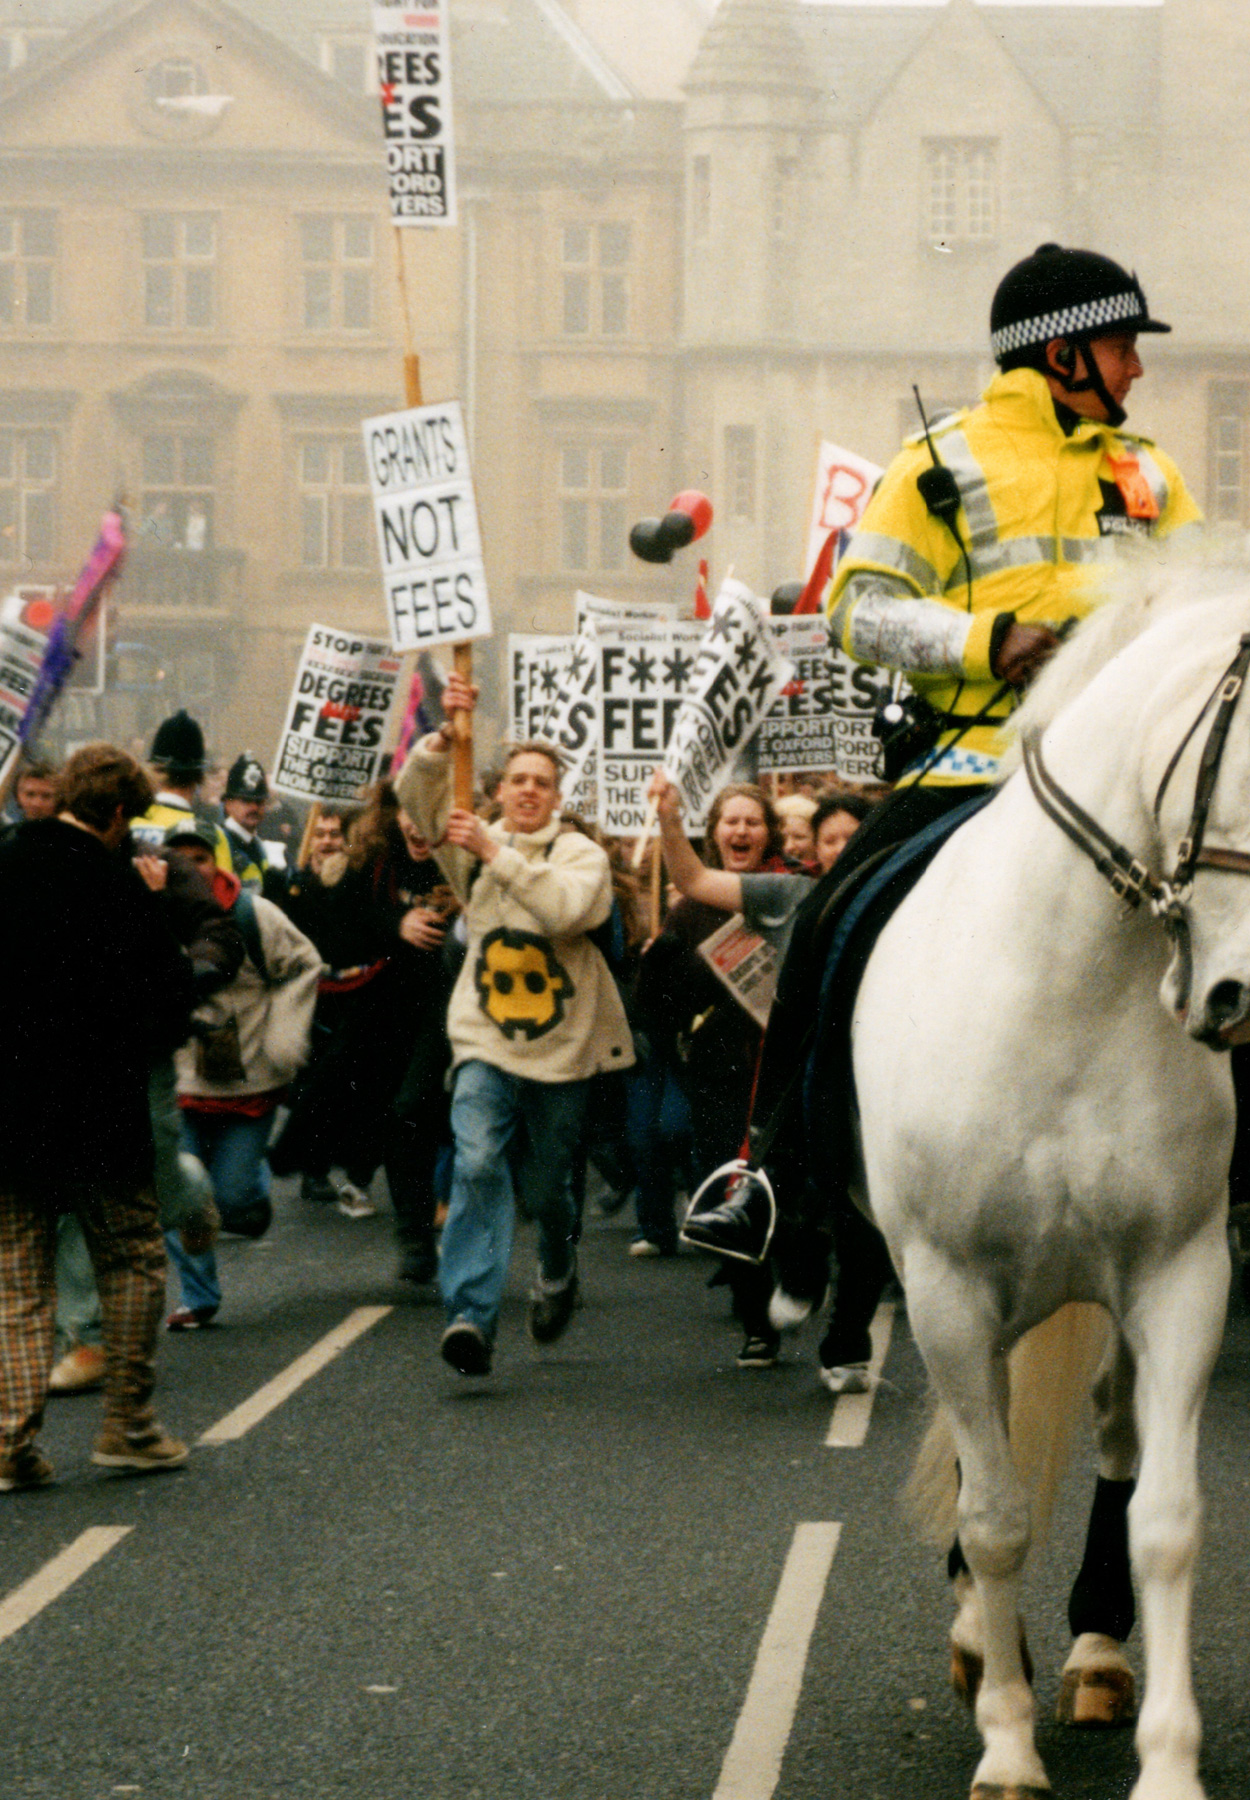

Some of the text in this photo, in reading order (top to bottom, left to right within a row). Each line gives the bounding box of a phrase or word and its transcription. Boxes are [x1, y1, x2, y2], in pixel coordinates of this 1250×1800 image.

[377, 52, 441, 86] EES
[371, 415, 458, 487] GRANTS
[381, 494, 461, 565] NOT
[391, 572, 477, 642] FEES
[312, 631, 364, 656] STOP
[618, 630, 667, 642] Socialist
[298, 670, 394, 712] DEGREES
[290, 700, 384, 748] FEES
[286, 736, 376, 770] SUPPORT
[605, 787, 641, 805] THE
